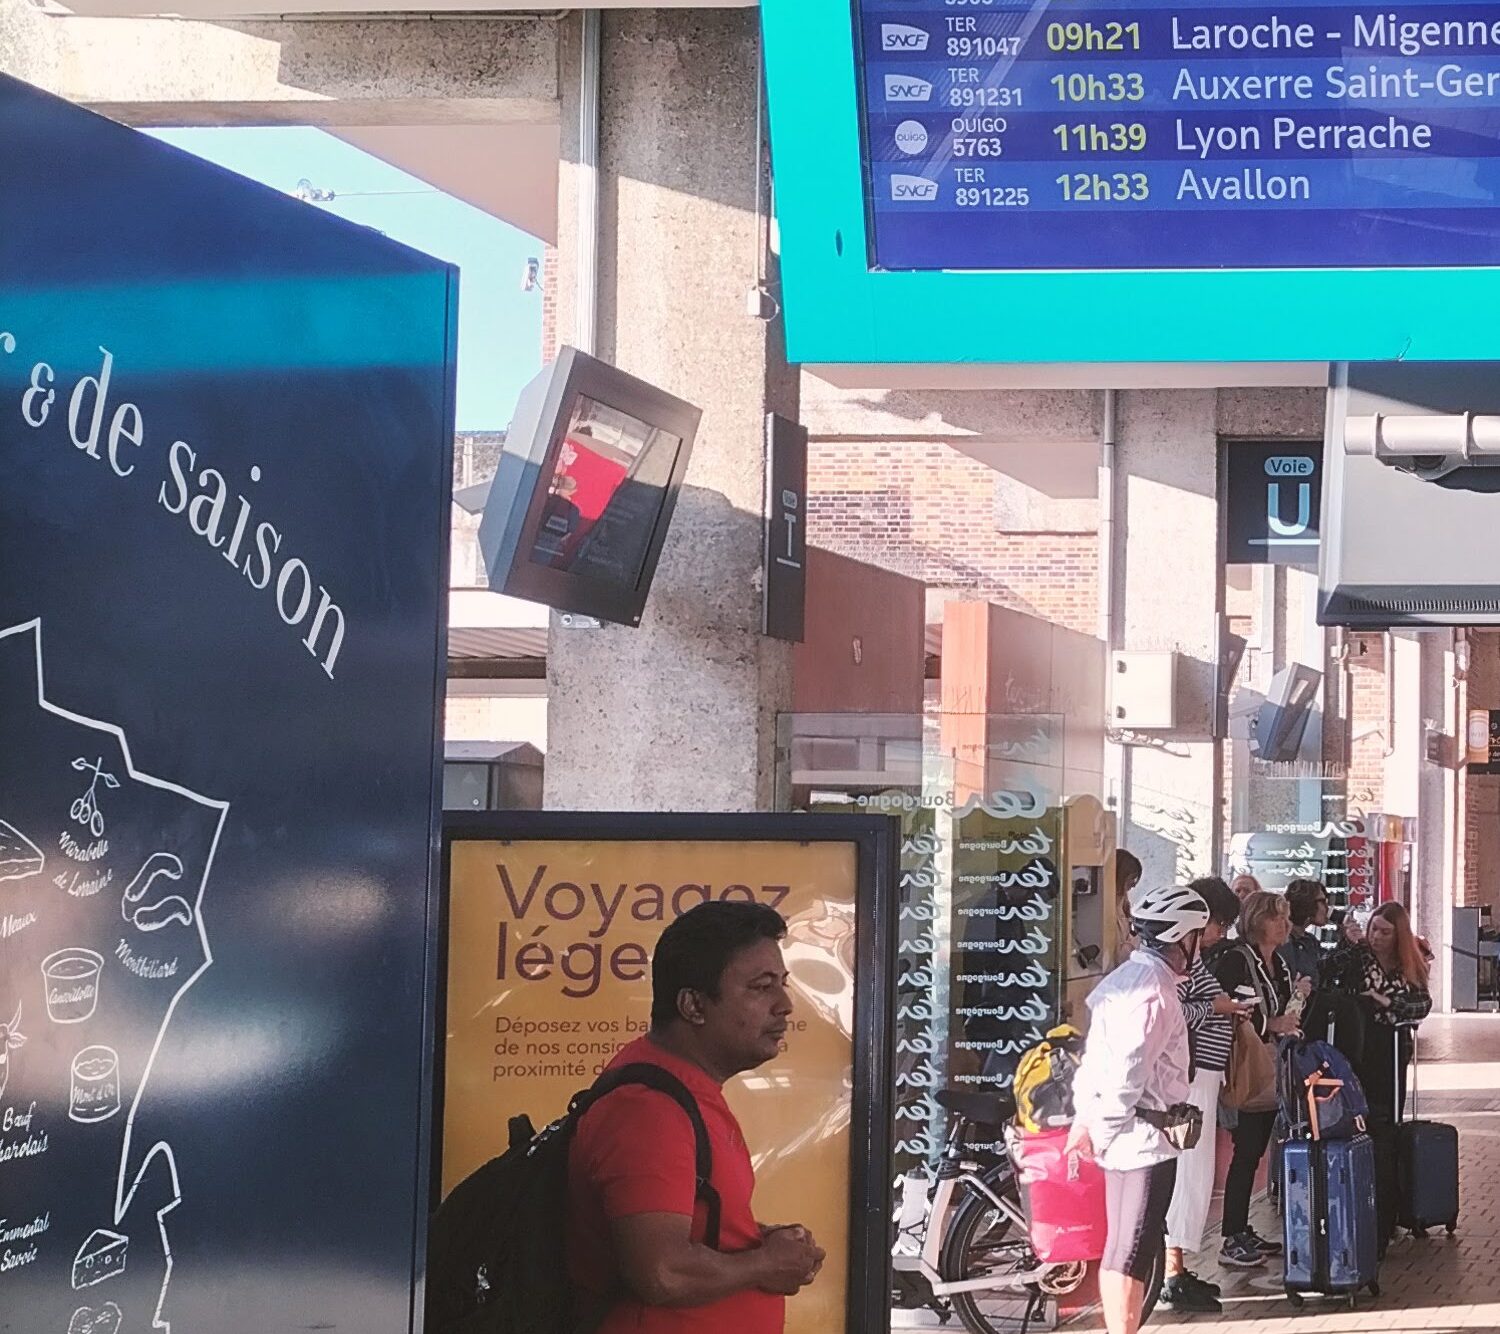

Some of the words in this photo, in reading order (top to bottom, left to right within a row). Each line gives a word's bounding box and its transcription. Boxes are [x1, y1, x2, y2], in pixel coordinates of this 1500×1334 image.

[945, 17, 976, 32] TER
[885, 33, 926, 48] SNCF
[946, 36, 1021, 57] 891047
[1046, 22, 1141, 52] 09h21
[1172, 16, 1315, 51] Laroche
[948, 68, 979, 83] TER
[888, 84, 929, 99] SNCF
[949, 87, 1023, 107] 891231
[1050, 73, 1145, 102] 10h33
[1172, 68, 1313, 101] Auxerre
[951, 117, 1007, 133] OUIGO
[952, 137, 1002, 157] 5763
[1052, 123, 1147, 152] 11h39
[1175, 118, 1260, 159] Lyon
[1273, 116, 1432, 151] Perrache
[954, 168, 985, 183] TER
[893, 183, 935, 198] SNCF
[955, 187, 1030, 207] 891225
[1055, 172, 1149, 201] 12h33
[1176, 168, 1311, 201] Avallon
[1270, 458, 1308, 474] Voie
[68, 345, 144, 477] de
[158, 440, 345, 679] saison
[1267, 483, 1310, 536] U
[495, 1017, 581, 1038] Déposez
[587, 1020, 620, 1034] vos
[494, 1040, 520, 1055] de
[526, 1042, 561, 1056] nos
[493, 1060, 586, 1082] proximité
